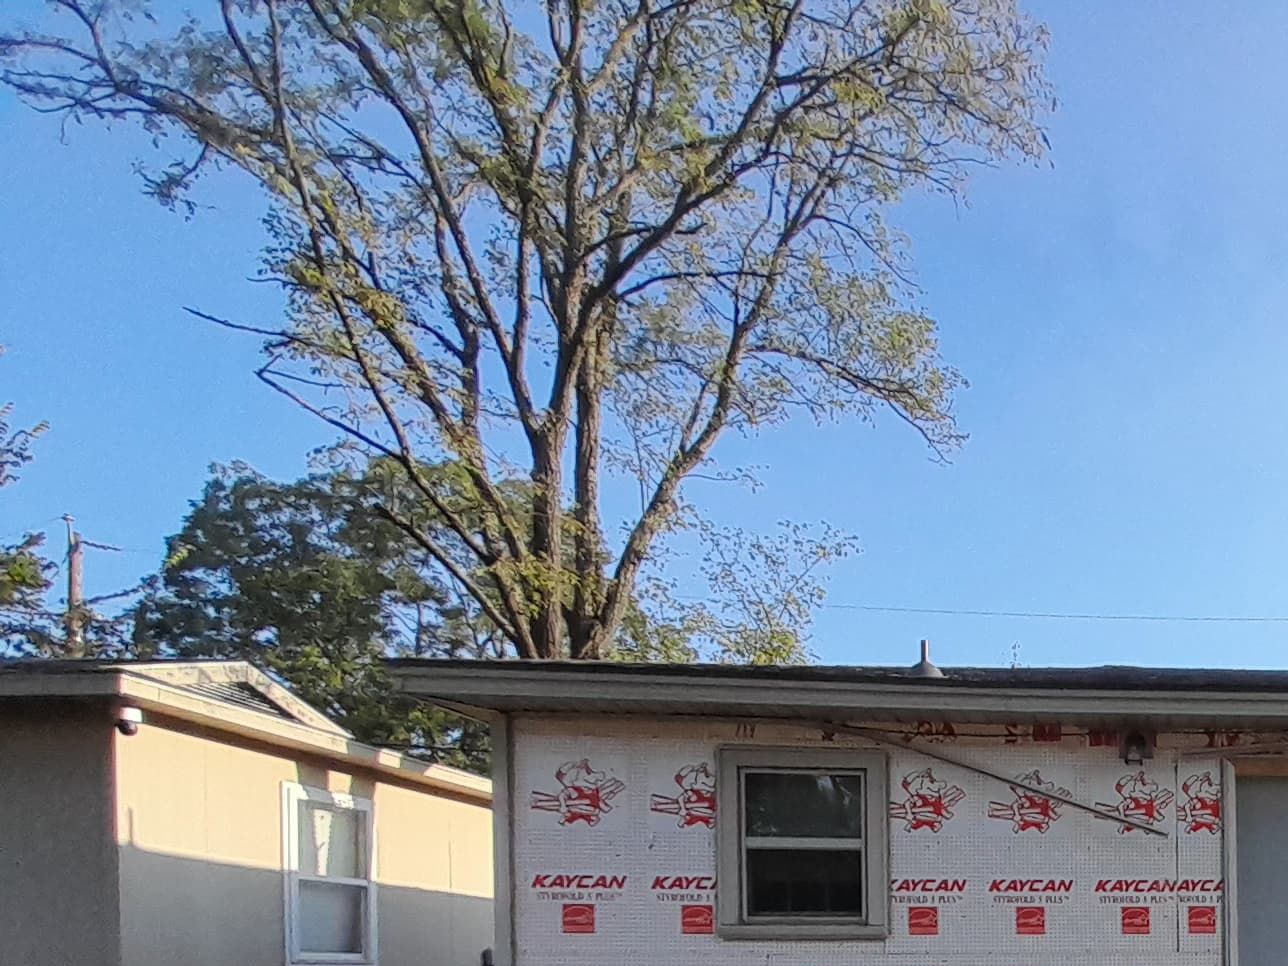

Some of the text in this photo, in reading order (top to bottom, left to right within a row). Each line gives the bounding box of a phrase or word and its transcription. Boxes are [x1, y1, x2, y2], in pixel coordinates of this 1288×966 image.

[531, 874, 627, 889] KAYCAN
[988, 879, 1074, 892] KAYCAN
[1095, 879, 1177, 893] KAYCAN
